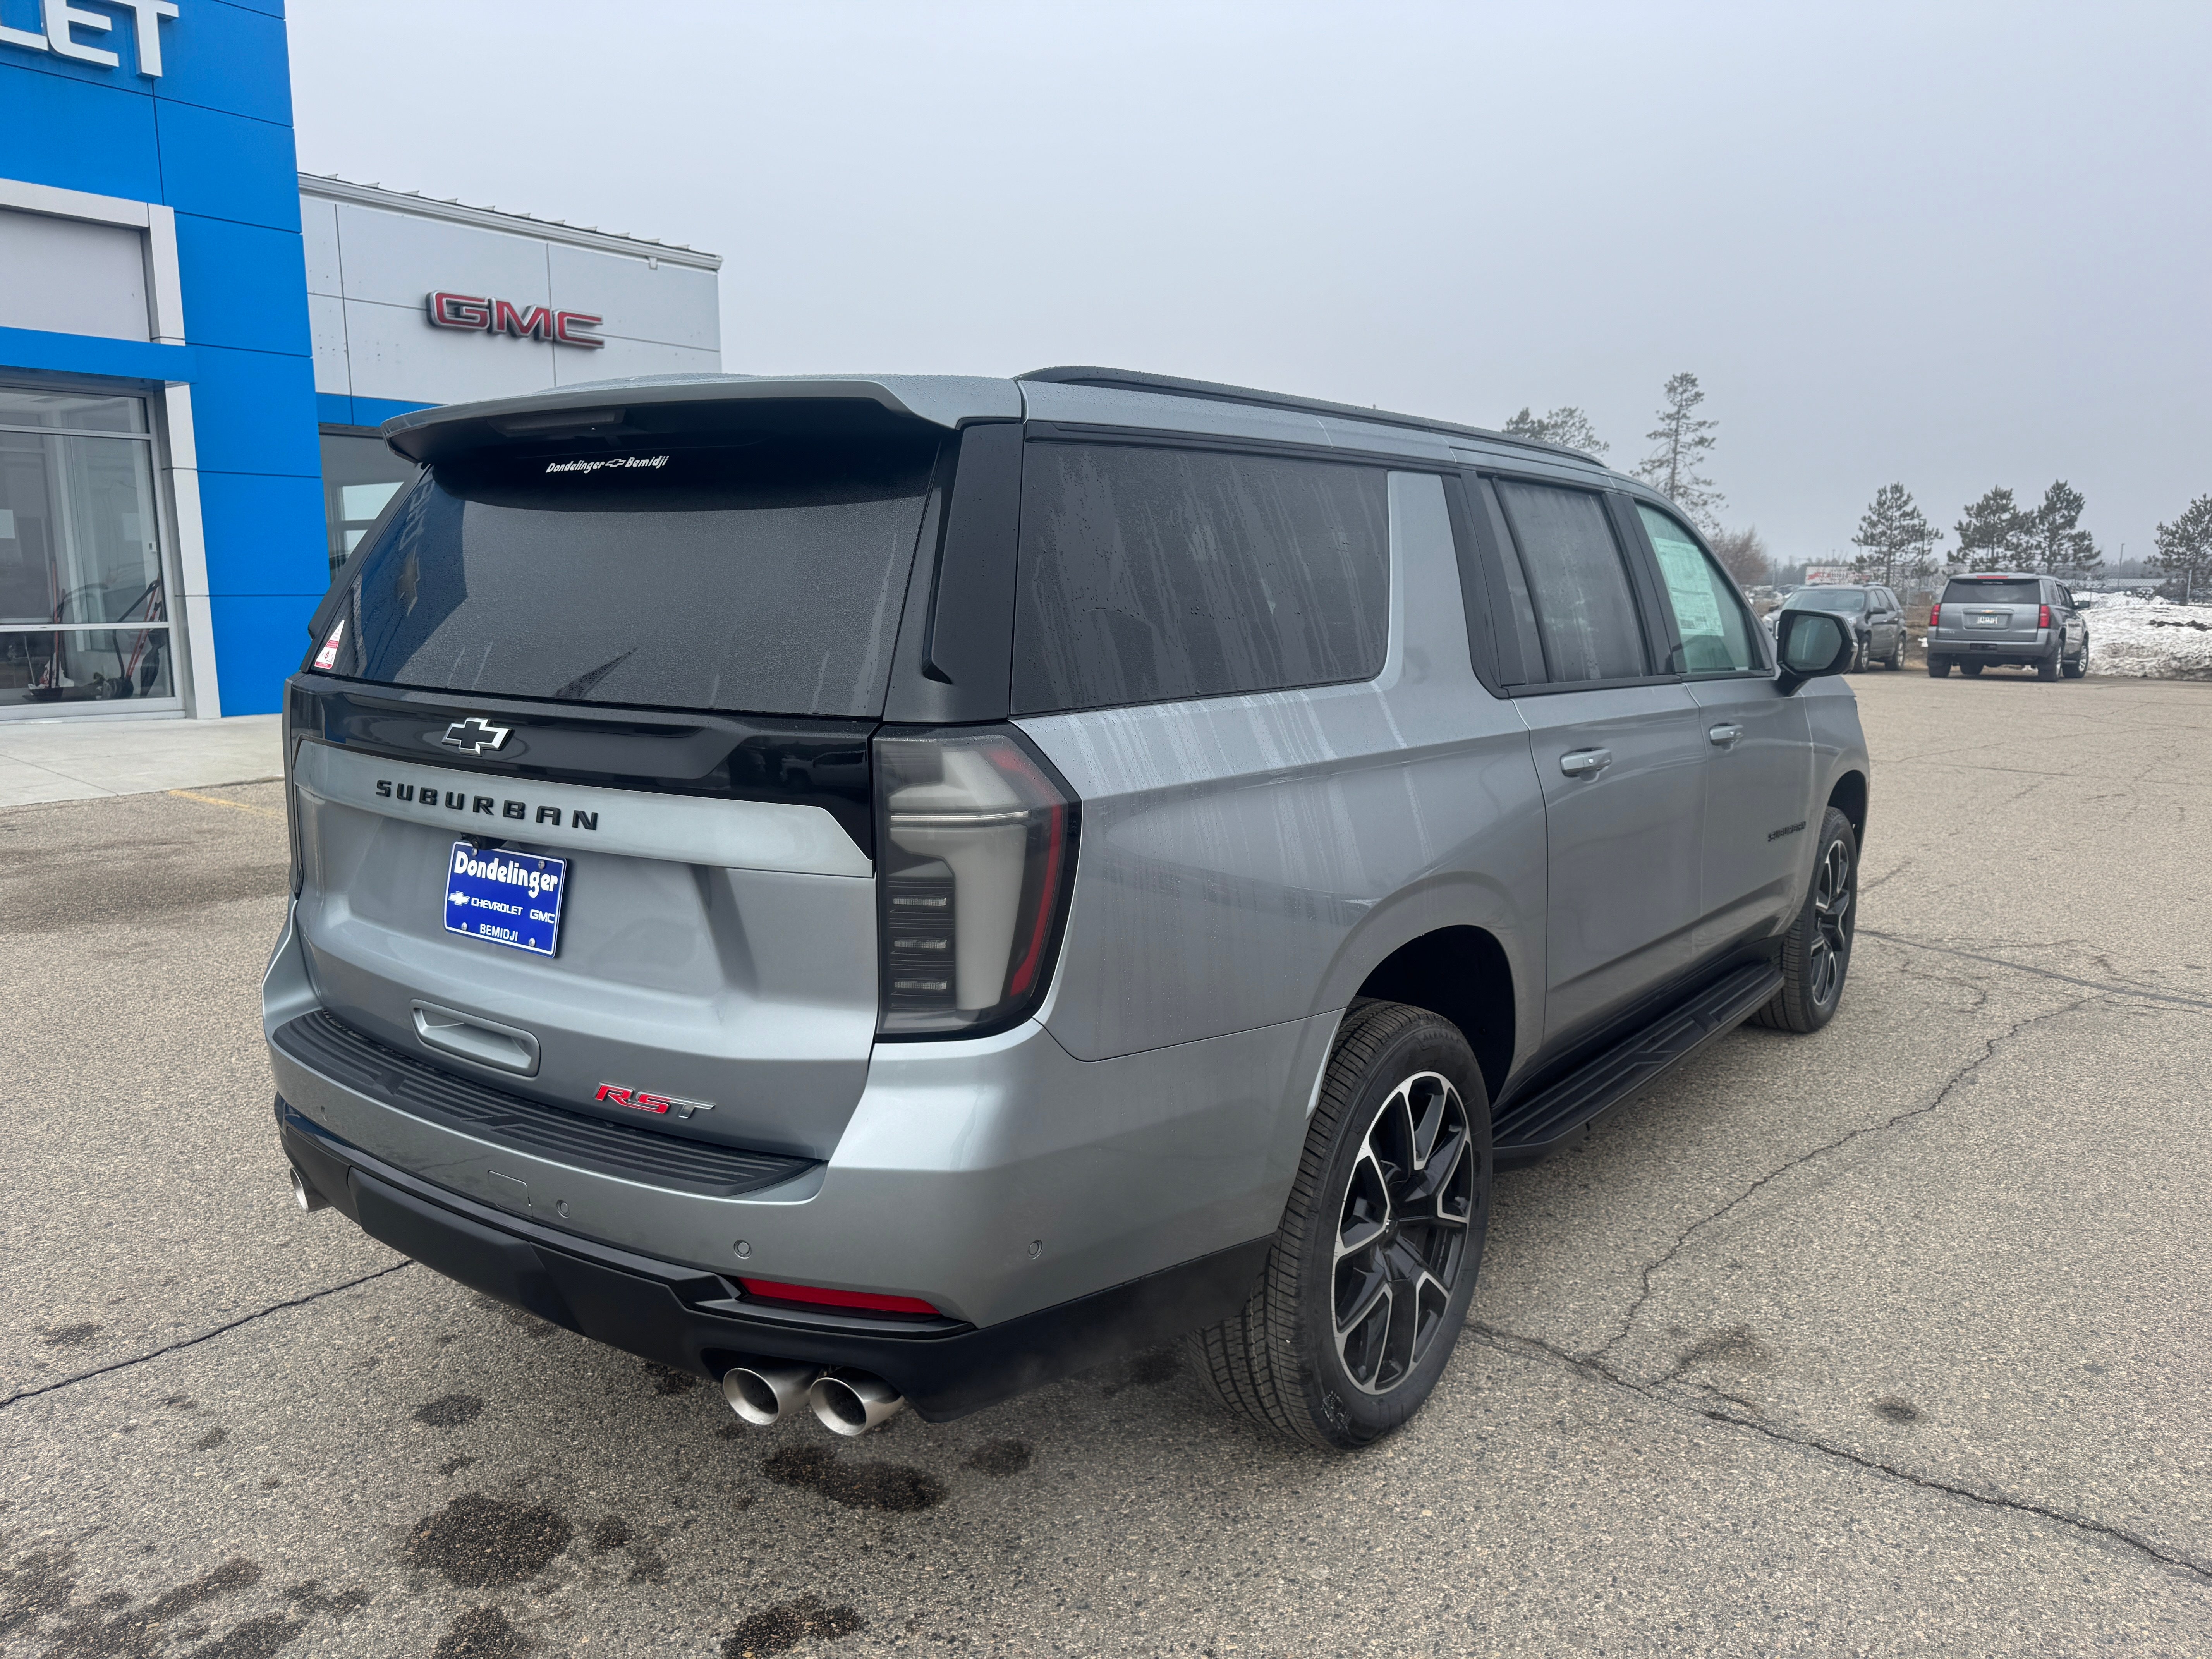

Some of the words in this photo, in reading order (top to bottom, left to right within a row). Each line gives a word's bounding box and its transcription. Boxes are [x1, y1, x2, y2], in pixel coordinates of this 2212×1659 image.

[427, 290, 605, 348] GMC
[546, 460, 605, 474] Dondelinger
[625, 455, 669, 469] Bemidji
[376, 780, 598, 831] SUBURBAN
[454, 850, 558, 898] Dondelinger
[471, 897, 524, 915] CHEVROLET
[530, 909, 555, 924] GMC
[480, 923, 518, 942] BEMIDJI
[594, 1082, 716, 1119] RST
